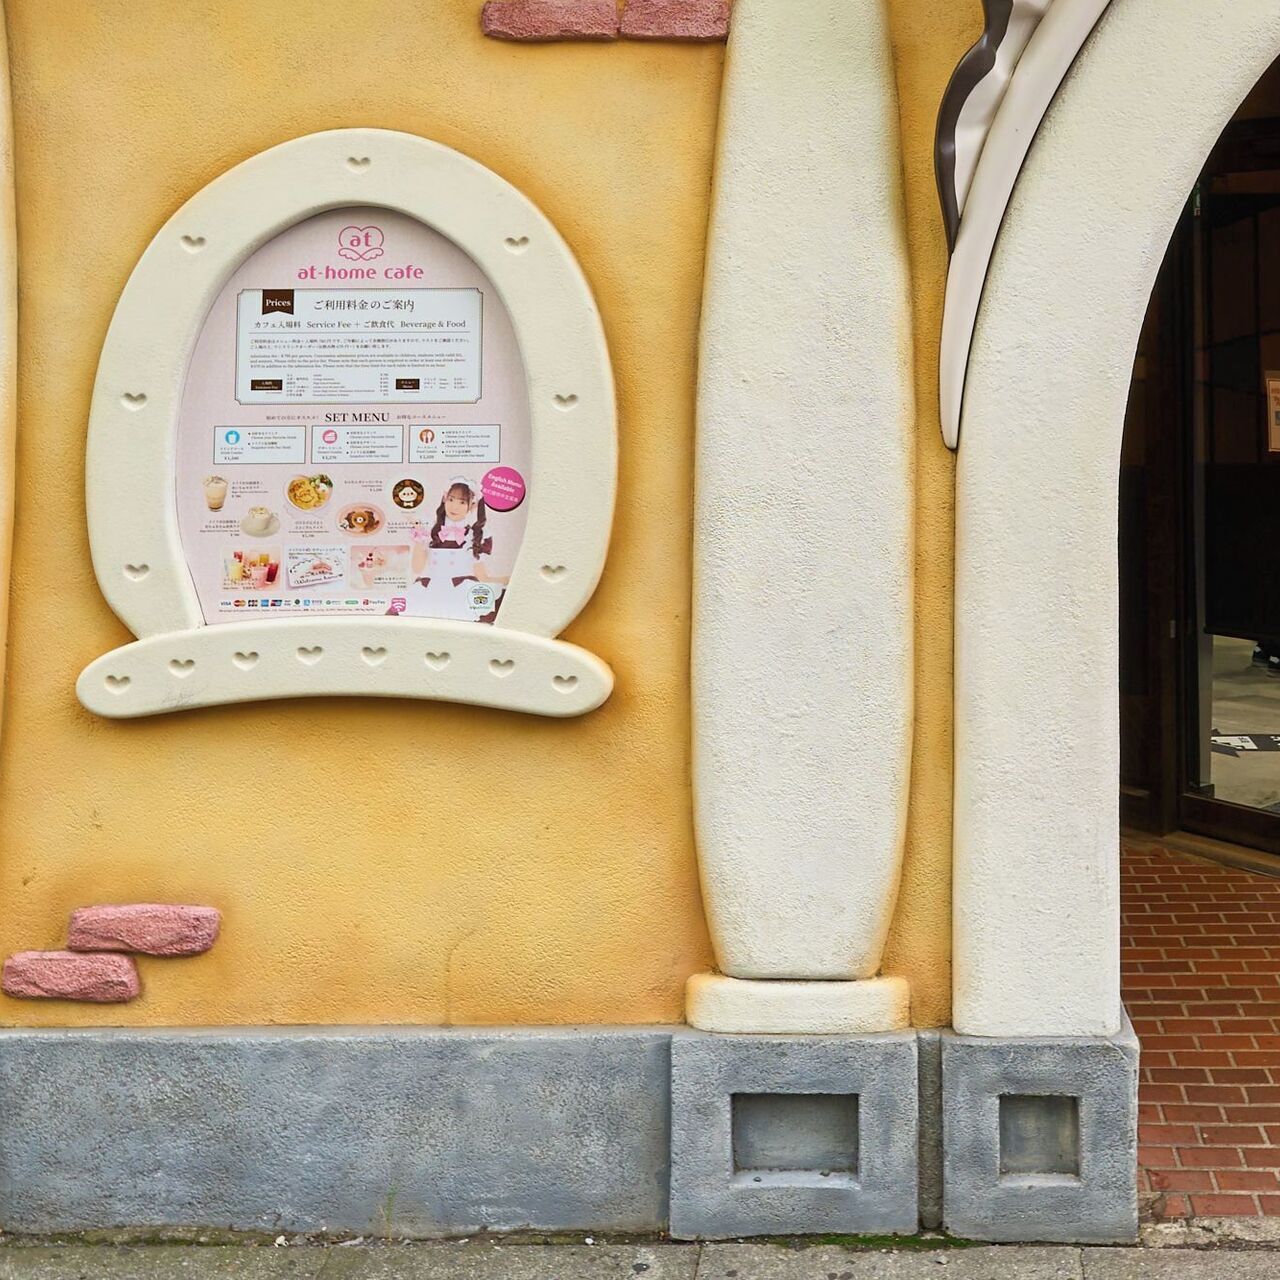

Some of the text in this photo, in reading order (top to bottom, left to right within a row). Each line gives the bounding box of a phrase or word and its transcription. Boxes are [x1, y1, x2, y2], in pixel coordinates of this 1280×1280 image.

[349, 231, 372, 247] at
[383, 264, 424, 280] cafe
[265, 298, 292, 307] Prices
[313, 299, 415, 312] ご利用料金のご案内
[363, 320, 395, 328] ご飲食代
[400, 320, 437, 329] Beverage
[446, 320, 466, 328] Food
[324, 412, 390, 423] SET MENU
